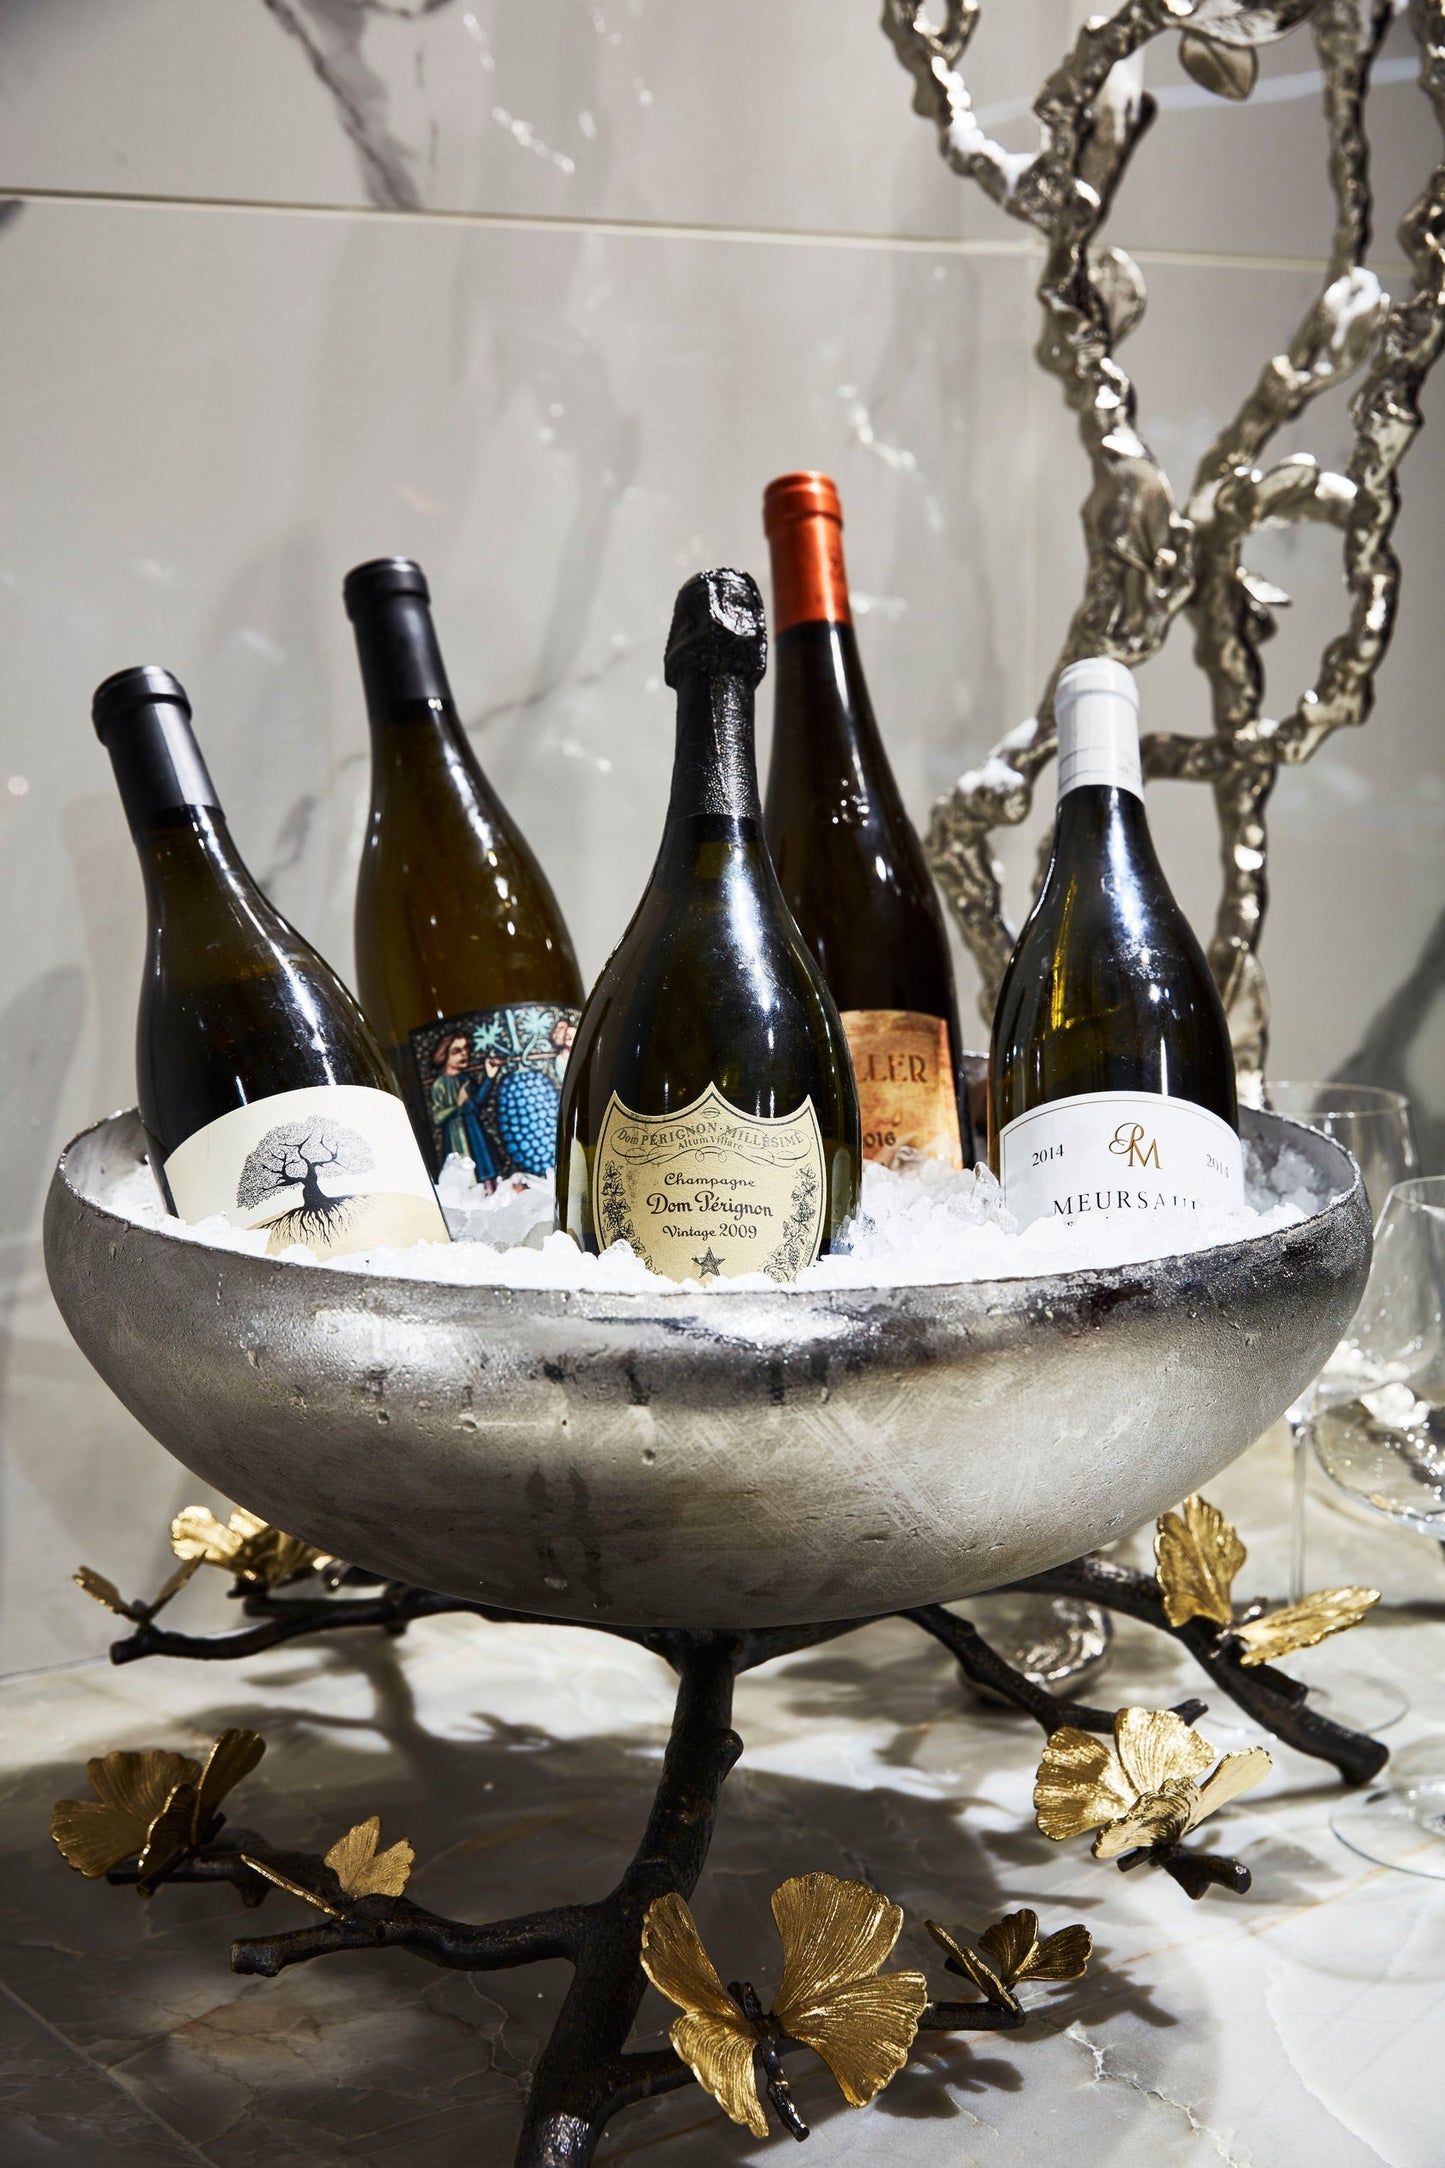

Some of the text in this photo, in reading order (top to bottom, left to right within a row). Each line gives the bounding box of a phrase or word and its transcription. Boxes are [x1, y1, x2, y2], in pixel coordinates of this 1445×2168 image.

[858, 1053, 927, 1083] LER
[617, 1128, 639, 1145] Dom
[678, 1136, 708, 1150] Altum
[1032, 1144, 1064, 1166] 2014
[1205, 1153, 1230, 1178] 2014
[664, 1172, 756, 1190] Champagne
[646, 1190, 773, 1220] Dom Pérignon
[662, 1222, 757, 1241] Vintage 2009
